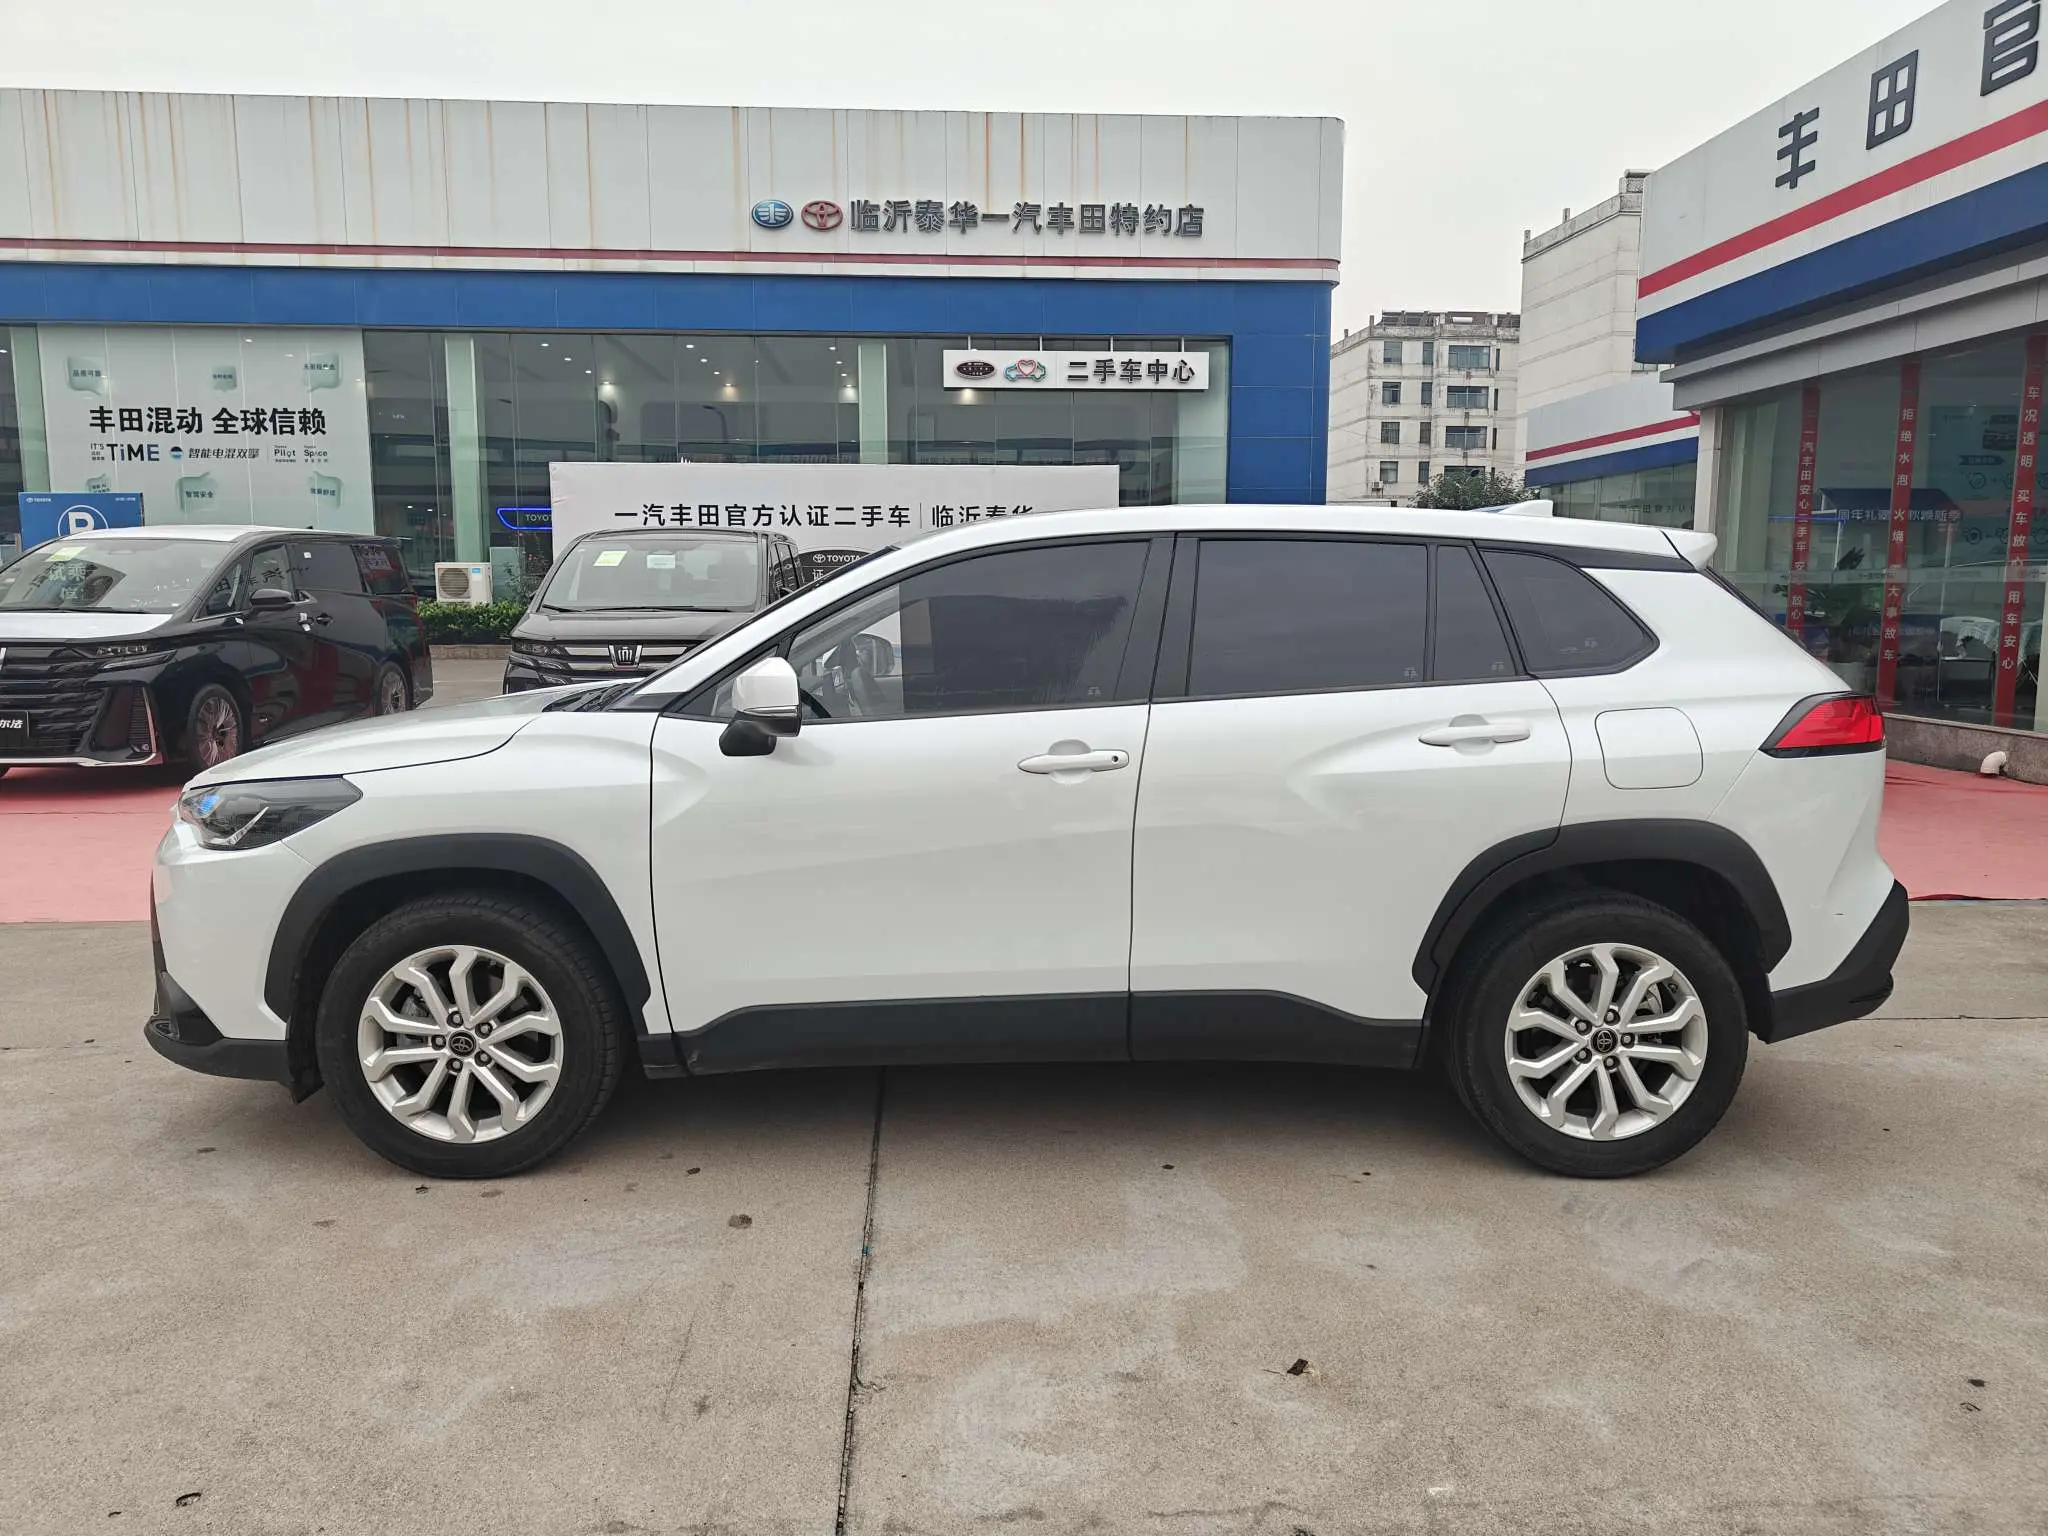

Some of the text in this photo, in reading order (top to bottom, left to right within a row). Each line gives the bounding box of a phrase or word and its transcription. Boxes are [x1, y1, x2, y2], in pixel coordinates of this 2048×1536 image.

[850, 199, 1205, 238] 临沂泰华一汽丰田特约店
[1066, 358, 1195, 384] 二手车中心
[89, 405, 327, 436] 丰田混动 全球信赖
[2019, 385, 2042, 468] 车况透明
[188, 447, 260, 460] 智能电混双擎
[1895, 407, 1916, 487] 拒绝水泡
[68, 512, 95, 530] P
[614, 503, 911, 528] 一汽丰田官方认证二手车
[826, 555, 860, 563] TOYOTA
[2001, 590, 2022, 670] 用车安心
